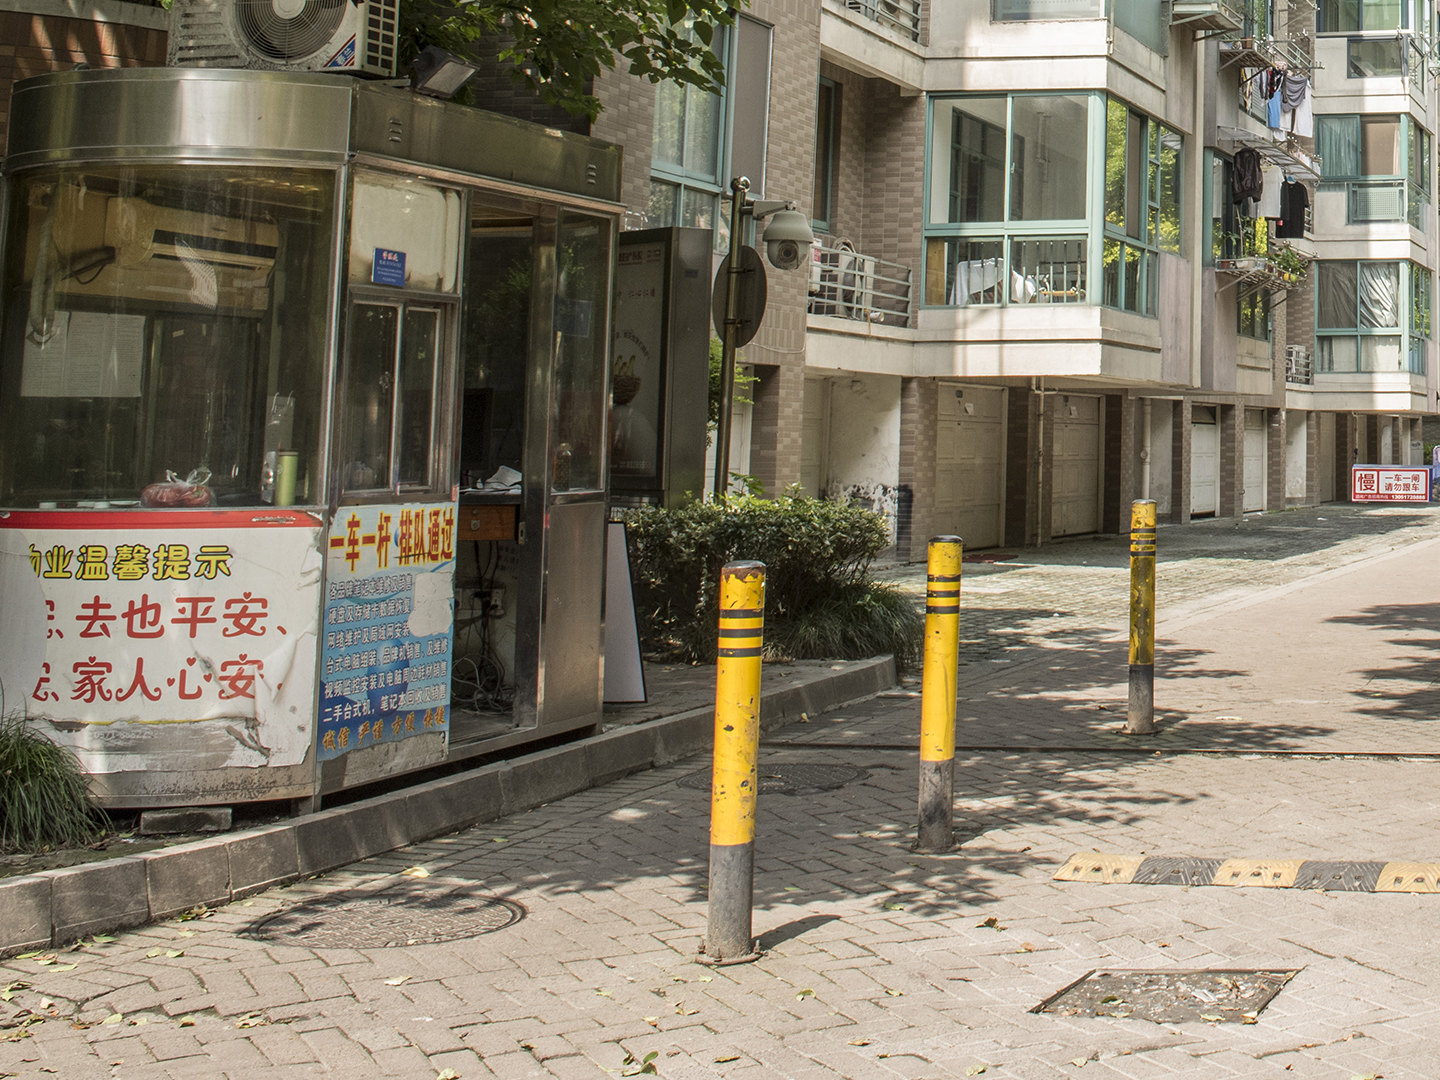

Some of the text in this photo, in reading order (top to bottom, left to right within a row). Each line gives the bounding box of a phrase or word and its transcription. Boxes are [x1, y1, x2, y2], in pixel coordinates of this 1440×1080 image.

[1357, 473, 1375, 492] 慢
[1385, 474, 1420, 483] 一车一闸
[1385, 483, 1420, 492] 请勿跟车
[330, 506, 455, 573] 一车一杆 排队通过
